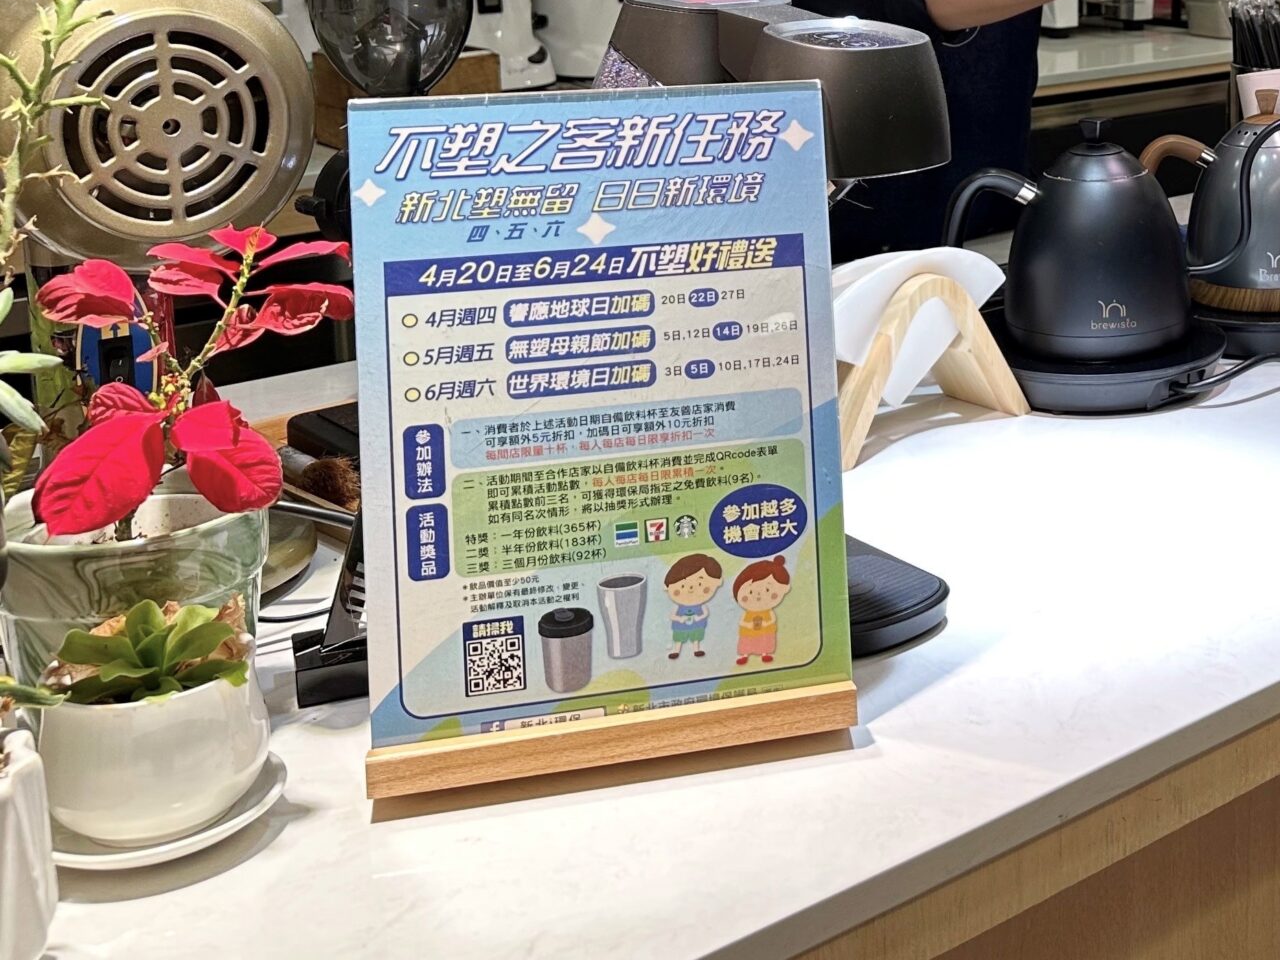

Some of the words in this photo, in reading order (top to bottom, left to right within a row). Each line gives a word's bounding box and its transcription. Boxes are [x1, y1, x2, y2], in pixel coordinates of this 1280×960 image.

[375, 109, 785, 181] 不塑之客新任務
[395, 183, 579, 225] 新北塑無留
[592, 172, 765, 213] 日日新環境
[425, 306, 497, 328] 4月週四
[508, 292, 651, 324] 響應地球日加碼
[661, 294, 686, 305] 20日
[690, 291, 716, 303] 22日
[720, 289, 745, 300] 27日
[1091, 317, 1137, 330] brewista
[422, 342, 495, 365] 5月週五
[508, 329, 651, 360] 無塑母親節加碼
[715, 324, 740, 337] 14日
[424, 378, 496, 401] 6月週六
[508, 363, 652, 395] 世界環境日加碼
[664, 365, 682, 377] 3日
[690, 363, 709, 374] 5日
[415, 429, 434, 494] 參加辦法
[722, 497, 797, 523] 參加越多
[419, 512, 437, 576] 活動獎品
[723, 519, 798, 545] 機會越大
[472, 620, 514, 638] 請掃我
